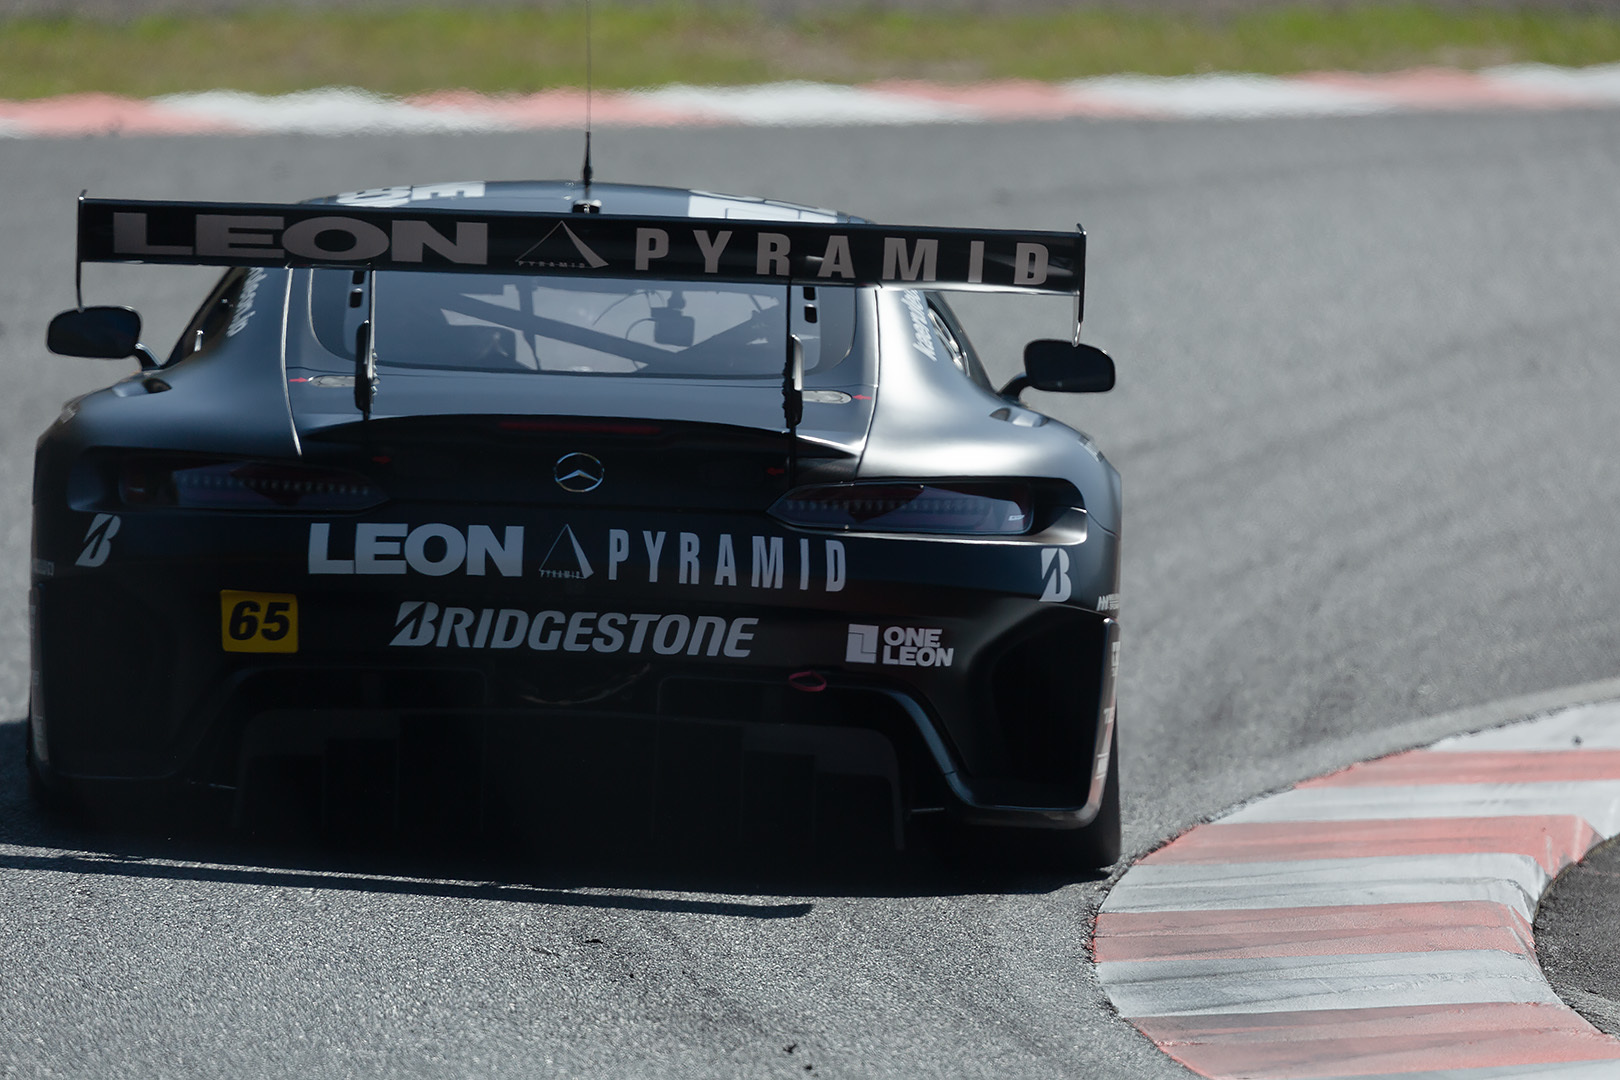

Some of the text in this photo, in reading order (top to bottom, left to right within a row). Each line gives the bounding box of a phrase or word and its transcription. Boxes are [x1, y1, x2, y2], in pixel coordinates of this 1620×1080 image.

[113, 211, 1051, 287] LEON PYRAMID
[308, 522, 848, 593] LEON PYRAMID
[228, 601, 291, 641] 65
[389, 601, 759, 658] BRIDGESTONE
[882, 625, 941, 649] ONE
[882, 644, 954, 668] LEON
